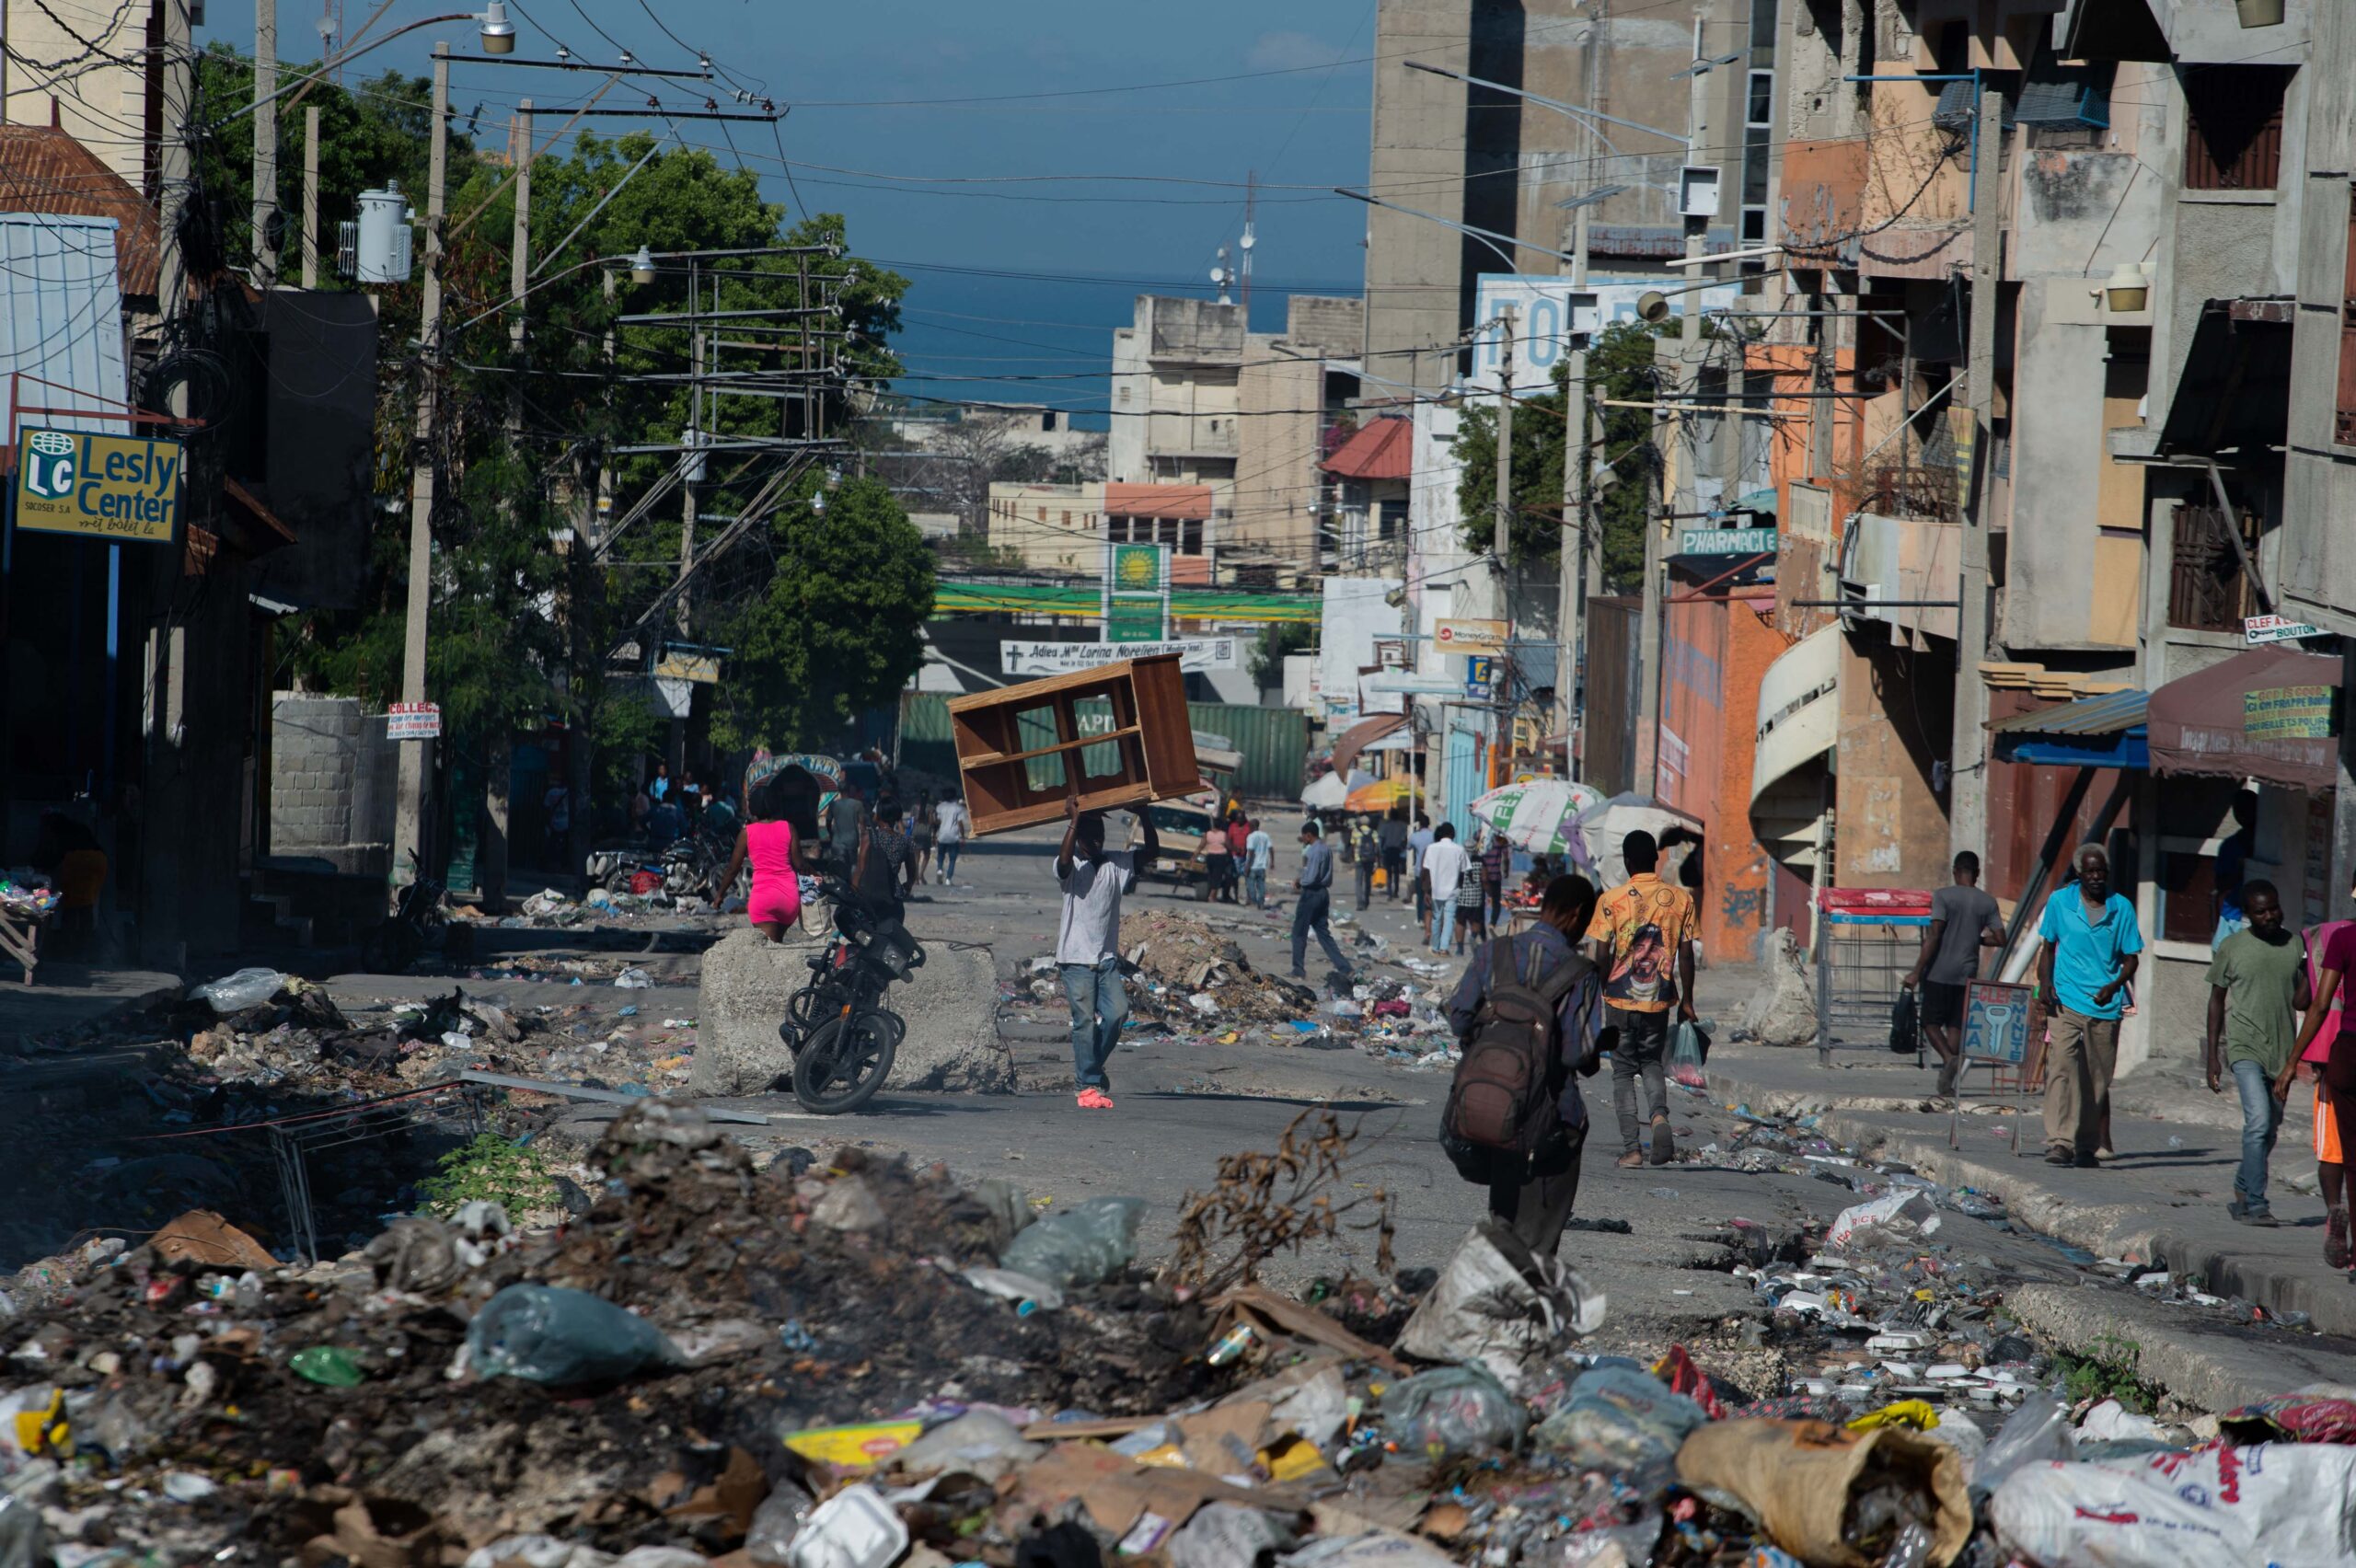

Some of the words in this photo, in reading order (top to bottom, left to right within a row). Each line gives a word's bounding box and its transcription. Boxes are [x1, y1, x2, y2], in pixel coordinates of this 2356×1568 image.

[80, 436, 177, 497] Lesly
[28, 453, 73, 496] LC
[25, 502, 55, 513] SOCOSER
[78, 481, 175, 524] Center
[1682, 531, 1776, 555] PHARMACIE
[2247, 617, 2272, 628] CLEF
[1453, 631, 1503, 641] MoneyGram
[2276, 626, 2317, 638] BOUTON
[1029, 645, 1057, 659] Adieu
[2273, 697, 2306, 709] FRAPPE
[1980, 986, 2012, 1004] CLEF
